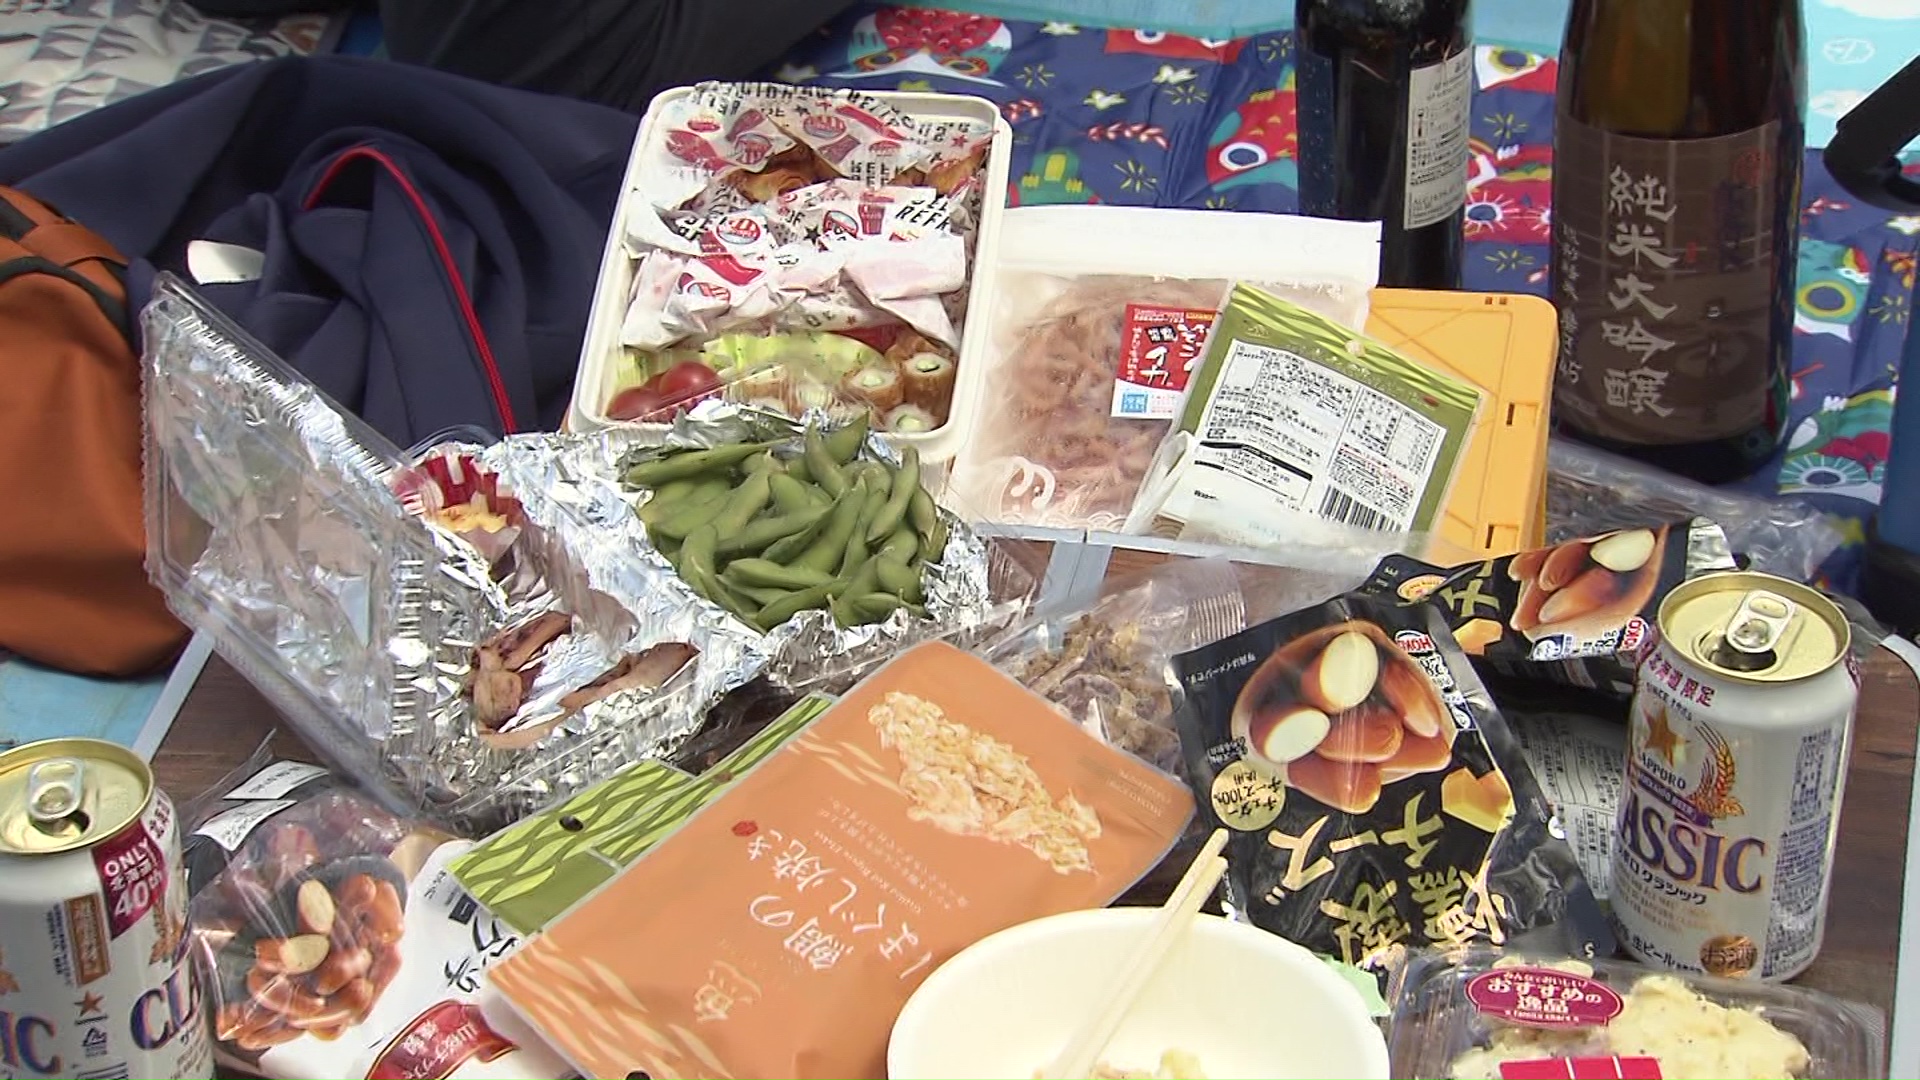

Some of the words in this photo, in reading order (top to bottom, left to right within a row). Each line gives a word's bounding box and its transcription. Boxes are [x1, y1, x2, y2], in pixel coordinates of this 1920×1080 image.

[1600, 164, 1678, 418] 純米大吟醸
[1638, 754, 1687, 791] APPORO
[103, 837, 152, 878] ONLY
[1265, 789, 1444, 907] チーズ
[1618, 788, 1766, 895] ASSIC
[747, 828, 933, 981] ほぐし焼き
[749, 893, 855, 973] 鯛の
[1487, 976, 1602, 1005] おすすめの
